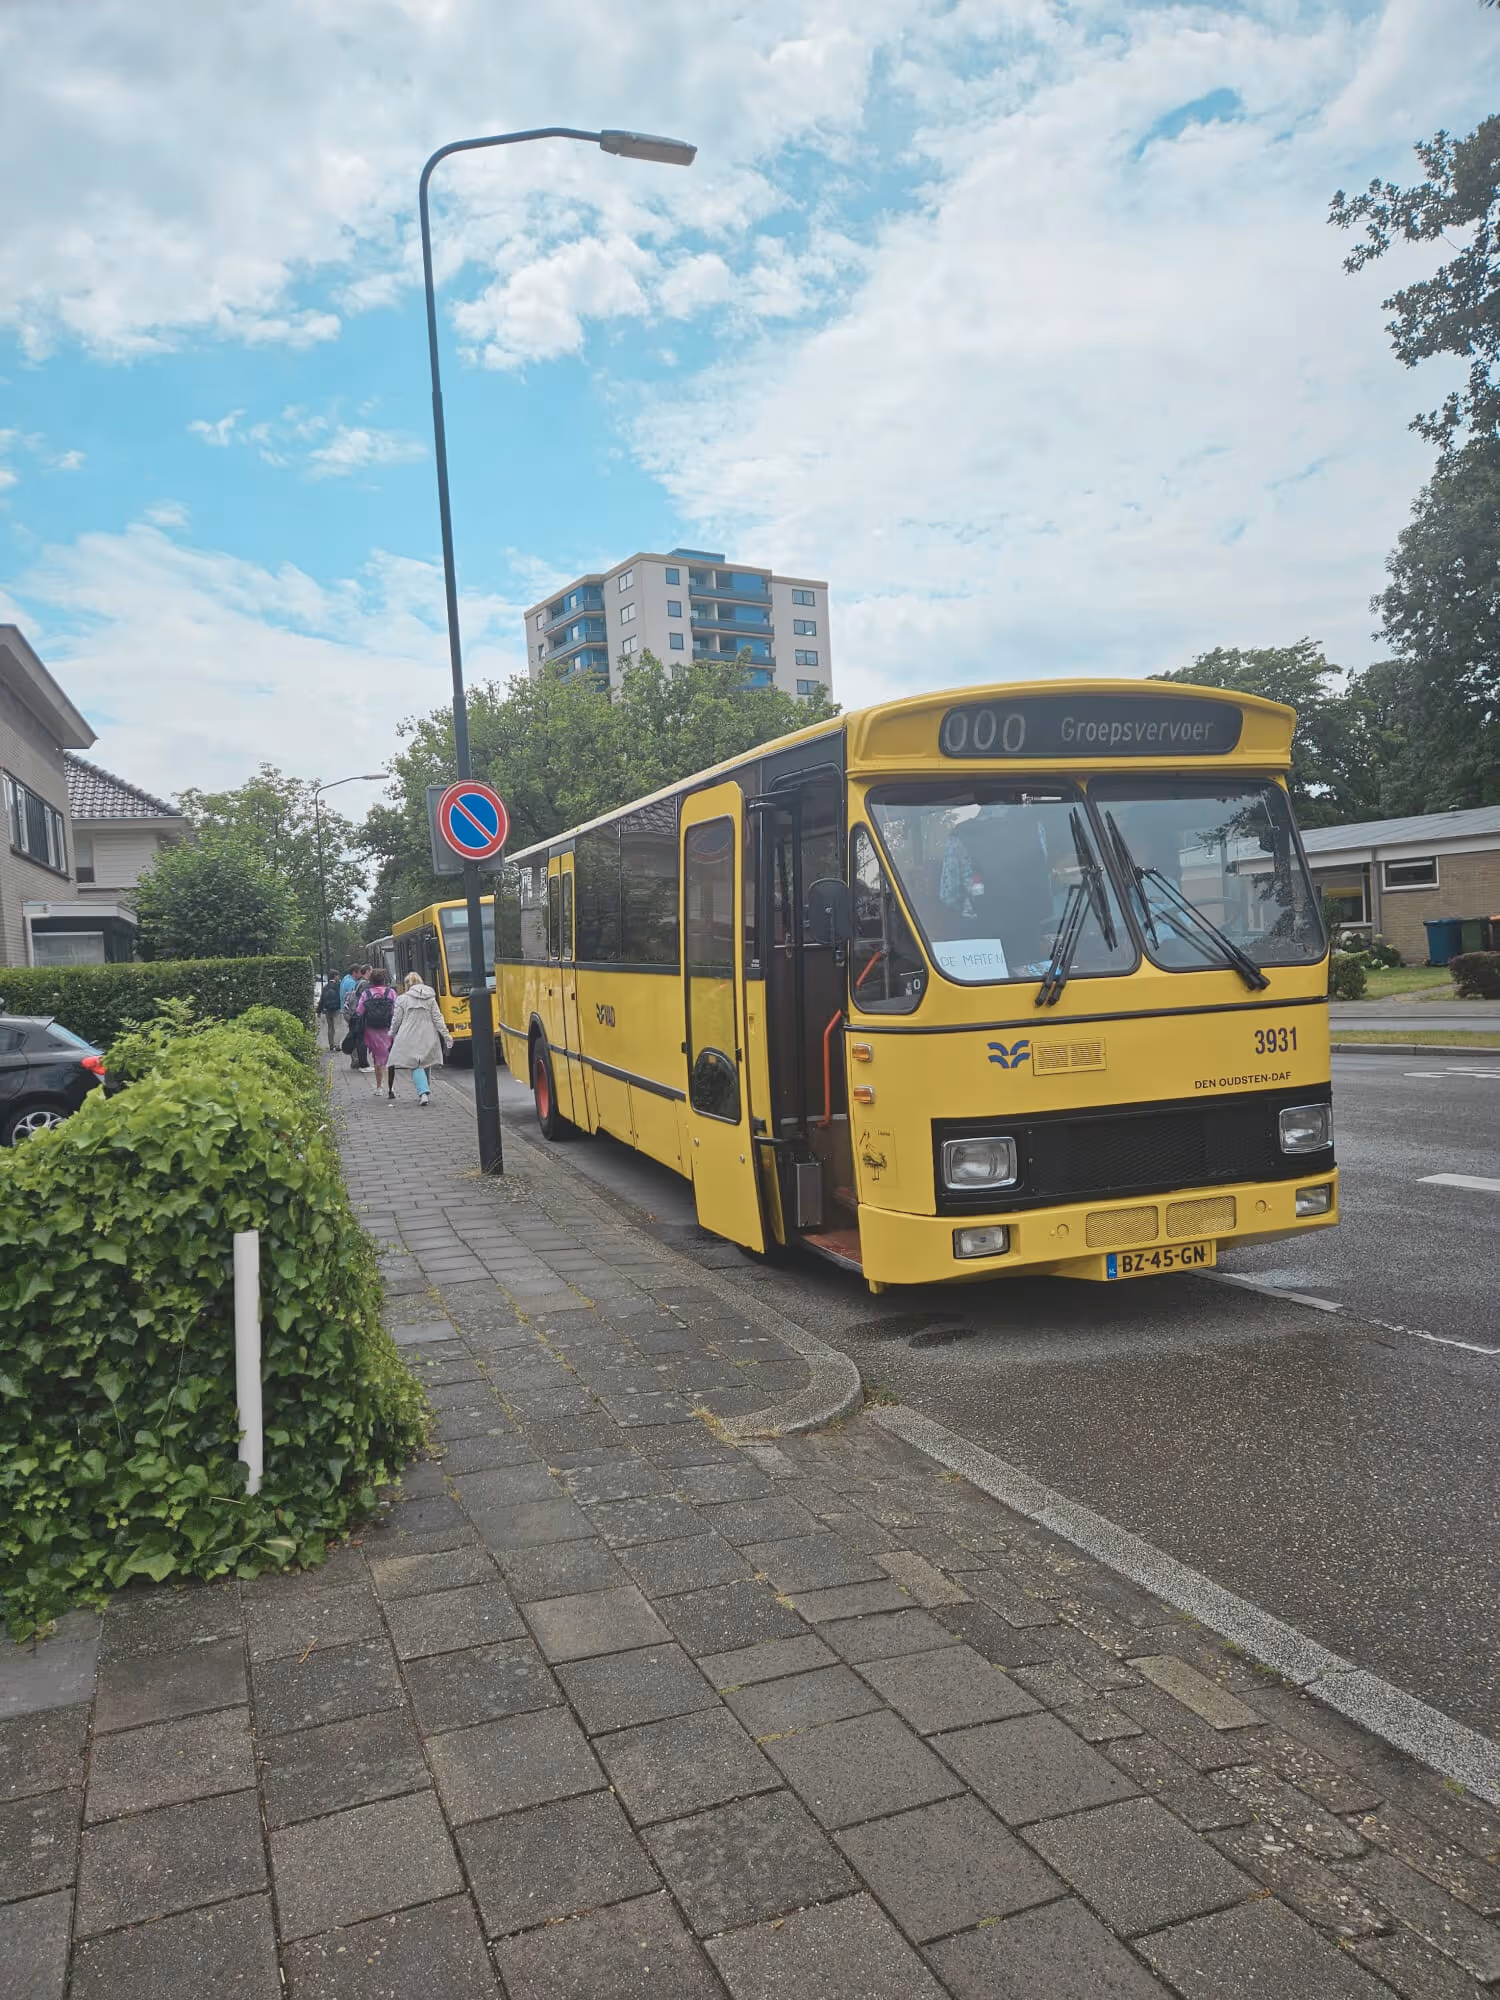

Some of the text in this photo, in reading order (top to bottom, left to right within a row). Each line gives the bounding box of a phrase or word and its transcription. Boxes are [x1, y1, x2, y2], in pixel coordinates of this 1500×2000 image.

[1060, 717, 1214, 746] Groepsvervoer
[939, 955, 957, 967] DE
[1254, 1026, 1297, 1054] 3931
[1194, 1071, 1292, 1089] DEN OUDSTEN-DAF
[1122, 1245, 1205, 1273] BZ-45-GN
